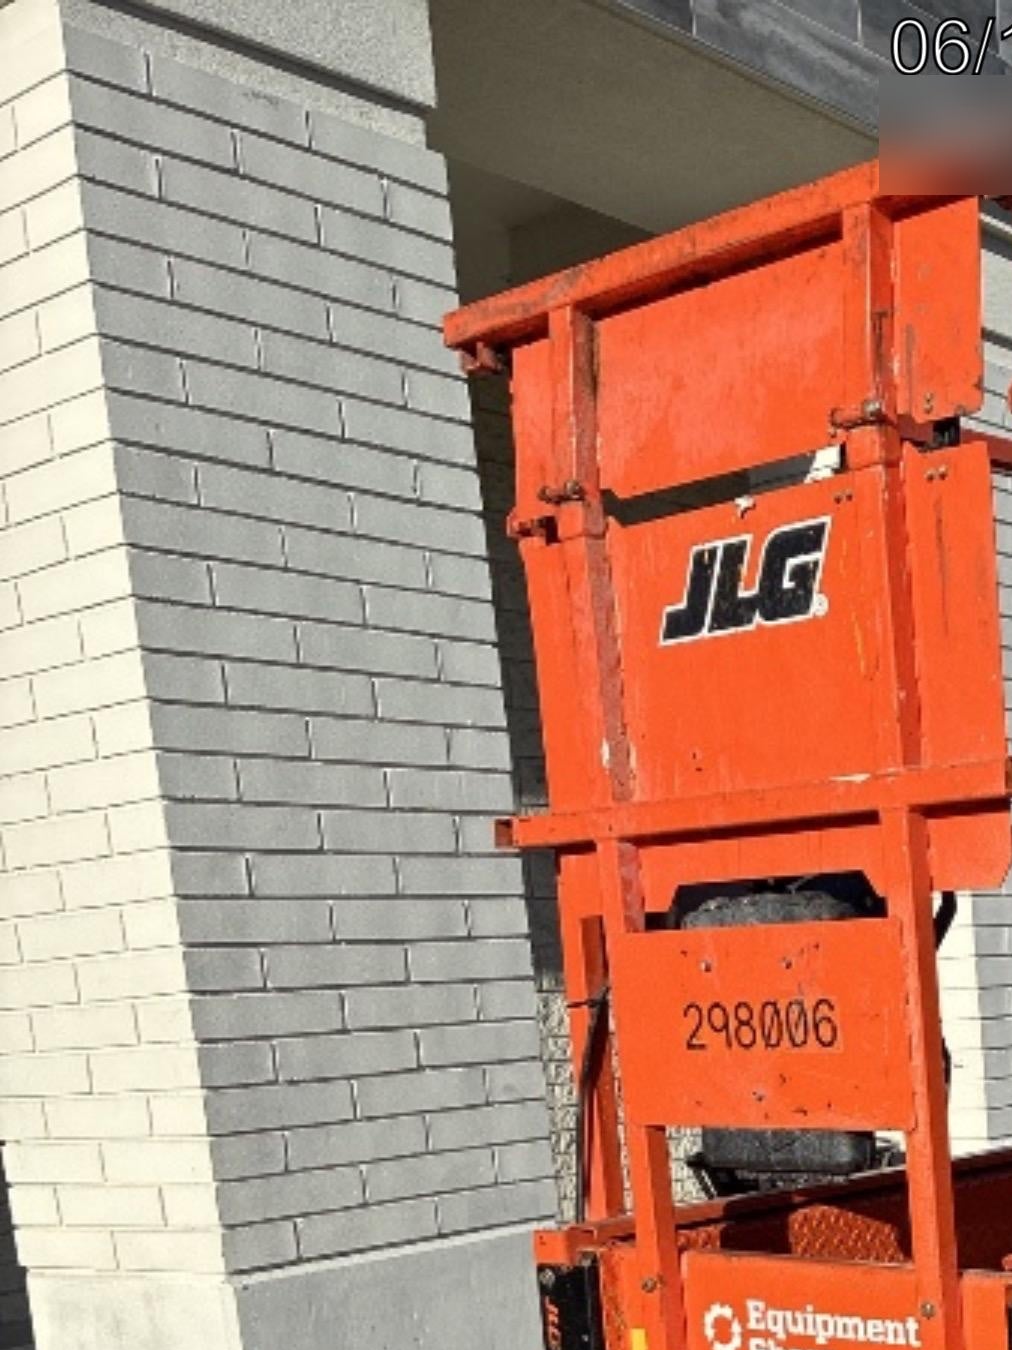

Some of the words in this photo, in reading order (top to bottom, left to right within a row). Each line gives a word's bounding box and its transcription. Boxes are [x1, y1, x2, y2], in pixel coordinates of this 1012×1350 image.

[659, 516, 831, 646] JLG
[683, 999, 839, 1051] 298006
[746, 1299, 923, 1348] Equipment
